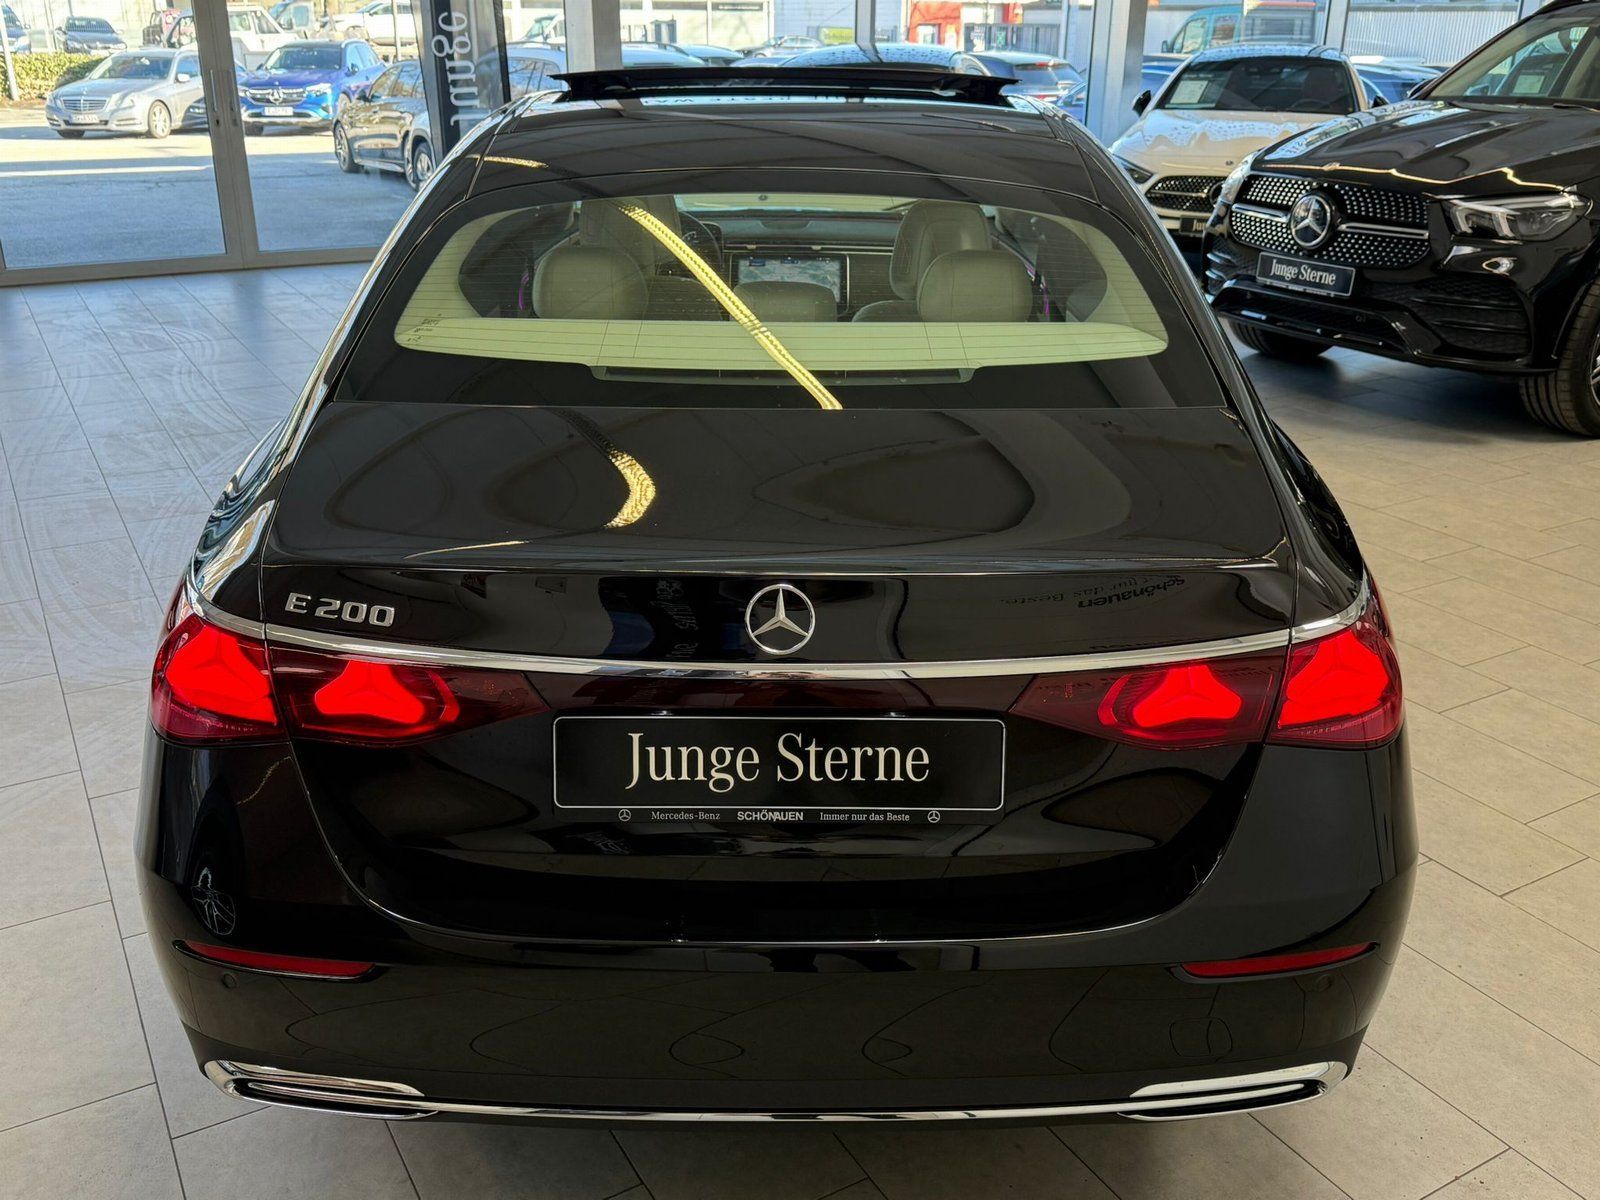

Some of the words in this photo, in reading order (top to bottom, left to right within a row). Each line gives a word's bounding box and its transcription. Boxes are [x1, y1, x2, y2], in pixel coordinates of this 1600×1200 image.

[1270, 259, 1299, 280] Junge
[1299, 264, 1337, 285] Sterne
[284, 592, 312, 613] E
[314, 598, 395, 627] 200
[625, 732, 760, 792] Junge
[776, 732, 930, 783] Sterne
[651, 811, 720, 820] Mercedes-Benz
[820, 812, 849, 820] Immer
[851, 812, 867, 820] nur
[869, 812, 884, 821] das
[886, 812, 910, 821] Beste
